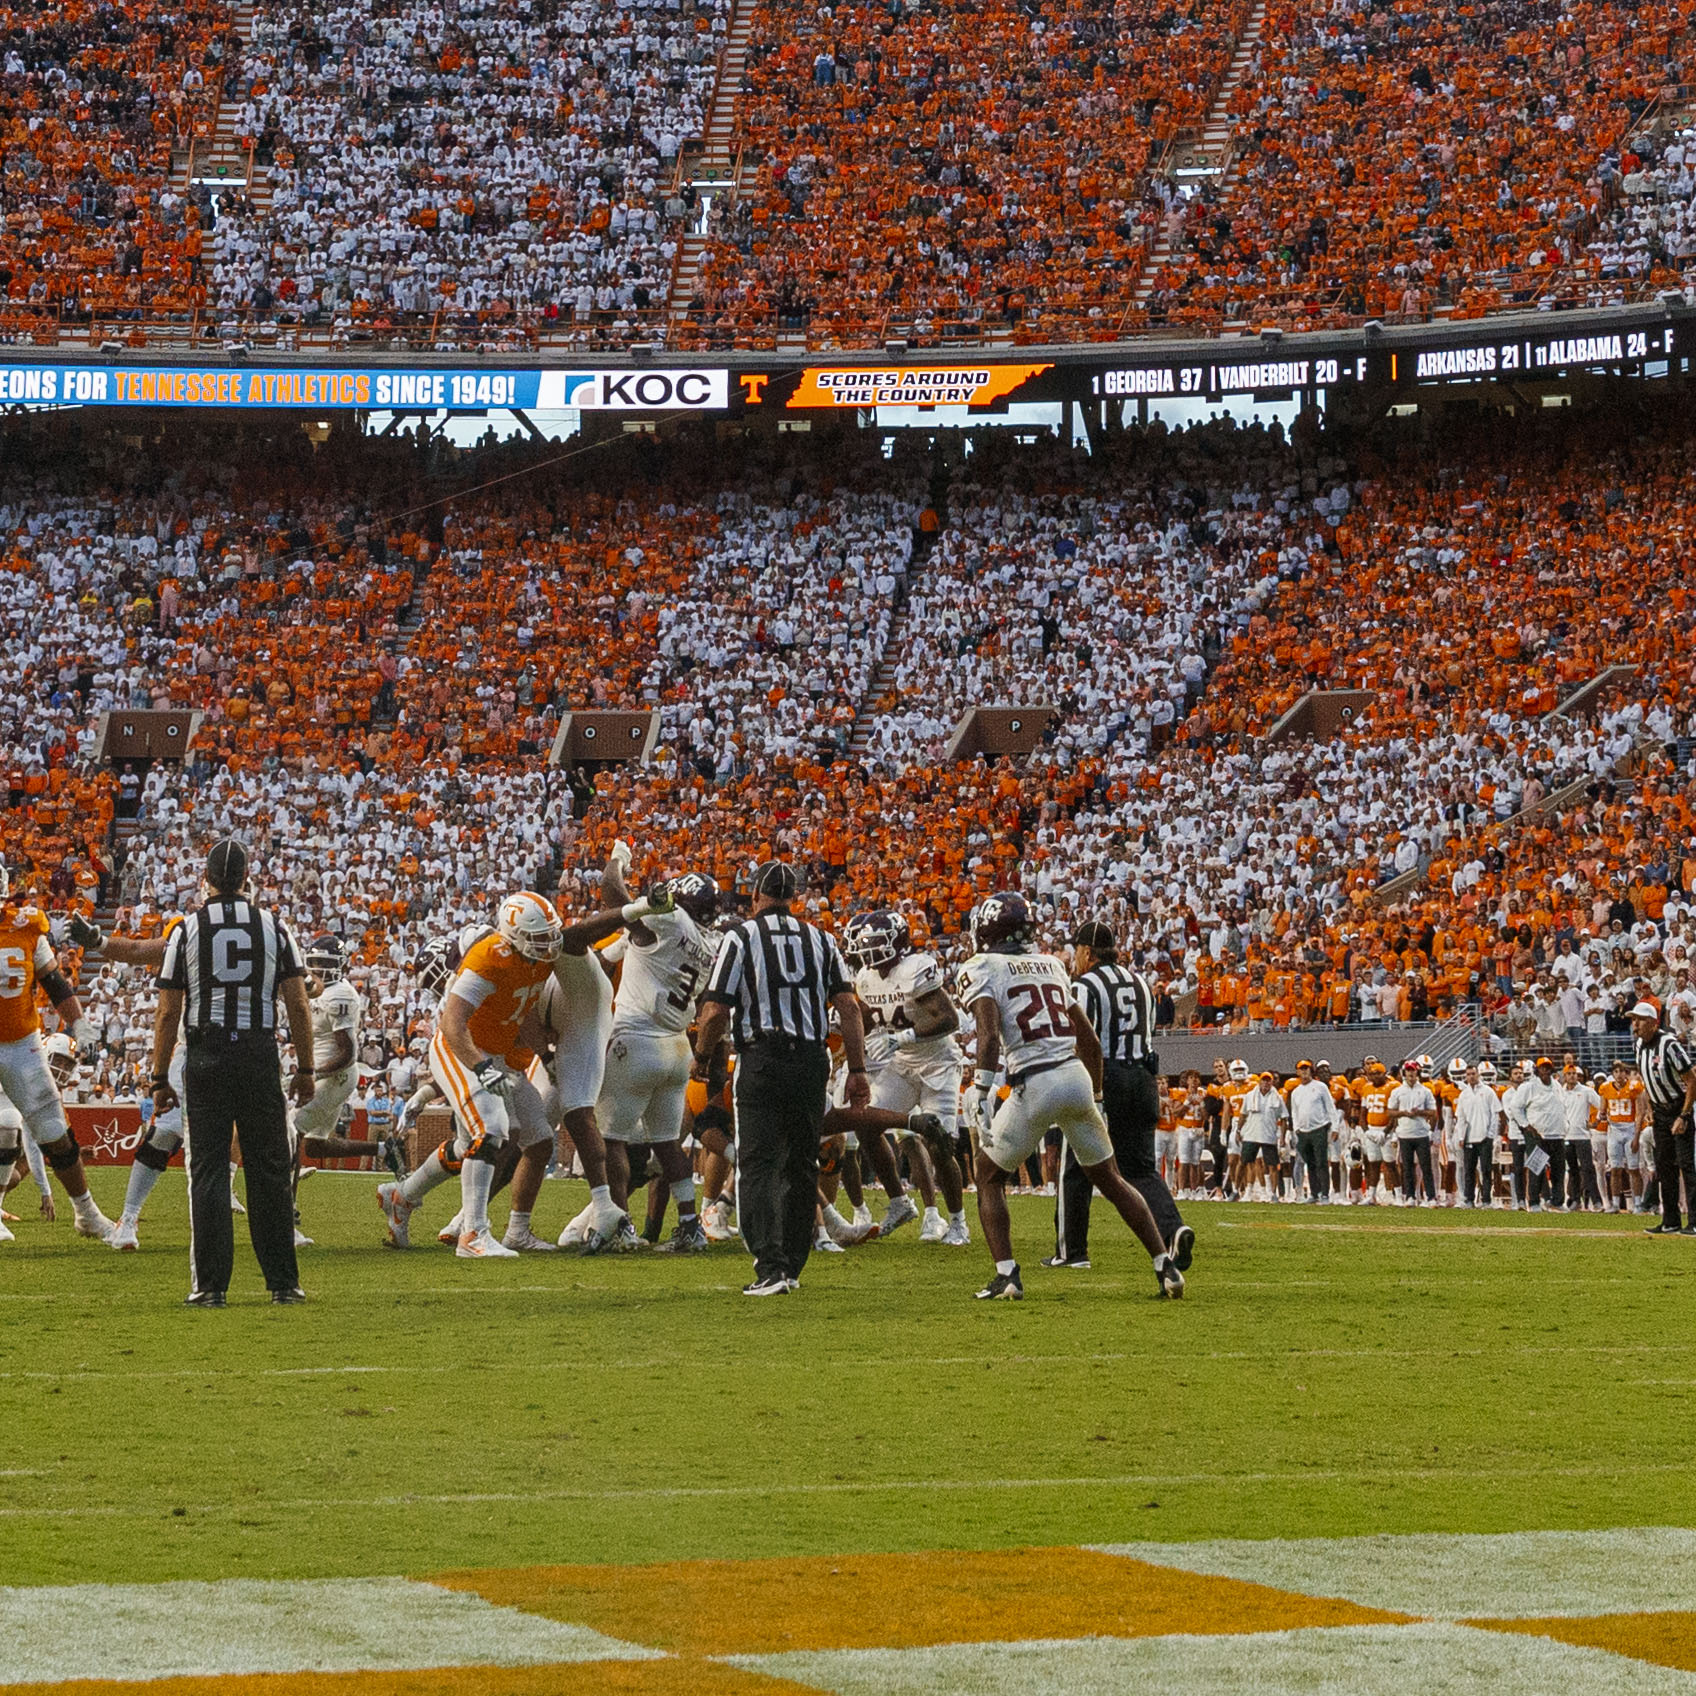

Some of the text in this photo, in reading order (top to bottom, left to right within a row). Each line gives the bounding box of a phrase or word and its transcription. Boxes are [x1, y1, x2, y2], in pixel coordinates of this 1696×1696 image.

[1416, 347, 1496, 377] ARKANSAS
[1501, 345, 1520, 369] 21
[1627, 332, 1647, 356] 24
[1664, 329, 1674, 353] F
[64, 369, 106, 400] FOR
[114, 371, 241, 402] TENNESSEE
[247, 374, 370, 403] ATHLETICS
[375, 374, 444, 404] SINCE
[450, 374, 515, 405] 1949!
[816, 371, 989, 389] SCORES AROUND
[1092, 358, 1367, 395] 1 GEORGIA 37 VANDERBILT 20 F
[602, 374, 712, 406] KOC
[740, 375, 769, 403] T
[833, 386, 977, 403] THE COUNTRY
[124, 726, 133, 736] N
[167, 726, 178, 736] O
[585, 727, 596, 738] O
[632, 728, 640, 738] P
[1012, 721, 1020, 732] P
[507, 904, 524, 926] T
[212, 929, 252, 982] C
[771, 935, 806, 983] U
[1008, 962, 1054, 977] DeBERRY
[668, 963, 699, 1011] 3
[865, 994, 886, 1004] TEXAS
[1116, 987, 1137, 1032] S
[1007, 983, 1076, 1042] 28
[1608, 1099, 1632, 1116] 90
